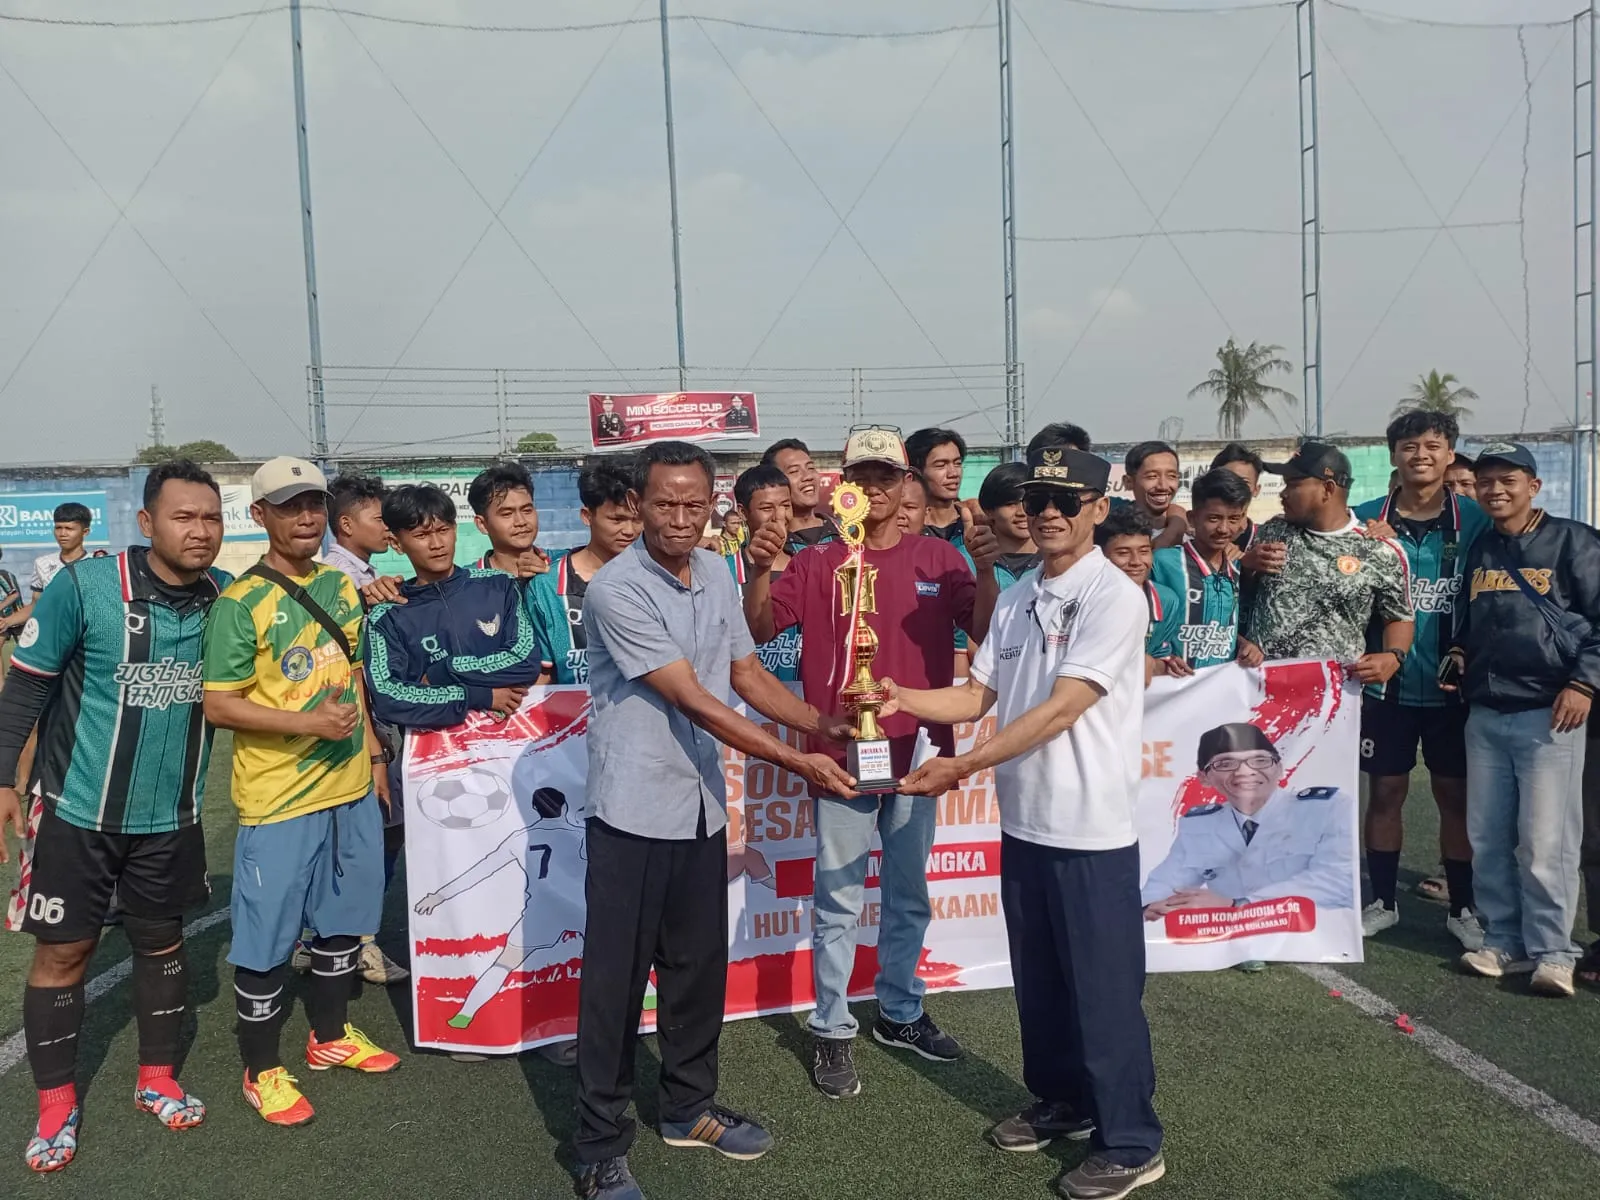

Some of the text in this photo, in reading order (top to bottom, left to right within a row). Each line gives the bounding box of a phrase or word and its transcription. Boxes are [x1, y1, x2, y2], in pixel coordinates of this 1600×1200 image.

[626, 403, 723, 416] MINI SOCCER CUP
[20, 510, 55, 521] BAN
[429, 649, 449, 663] ADM
[726, 762, 804, 801] SOC
[529, 843, 552, 880] 7
[29, 893, 64, 924] 06
[1179, 913, 1209, 925] FARID
[754, 910, 802, 939] HUT
